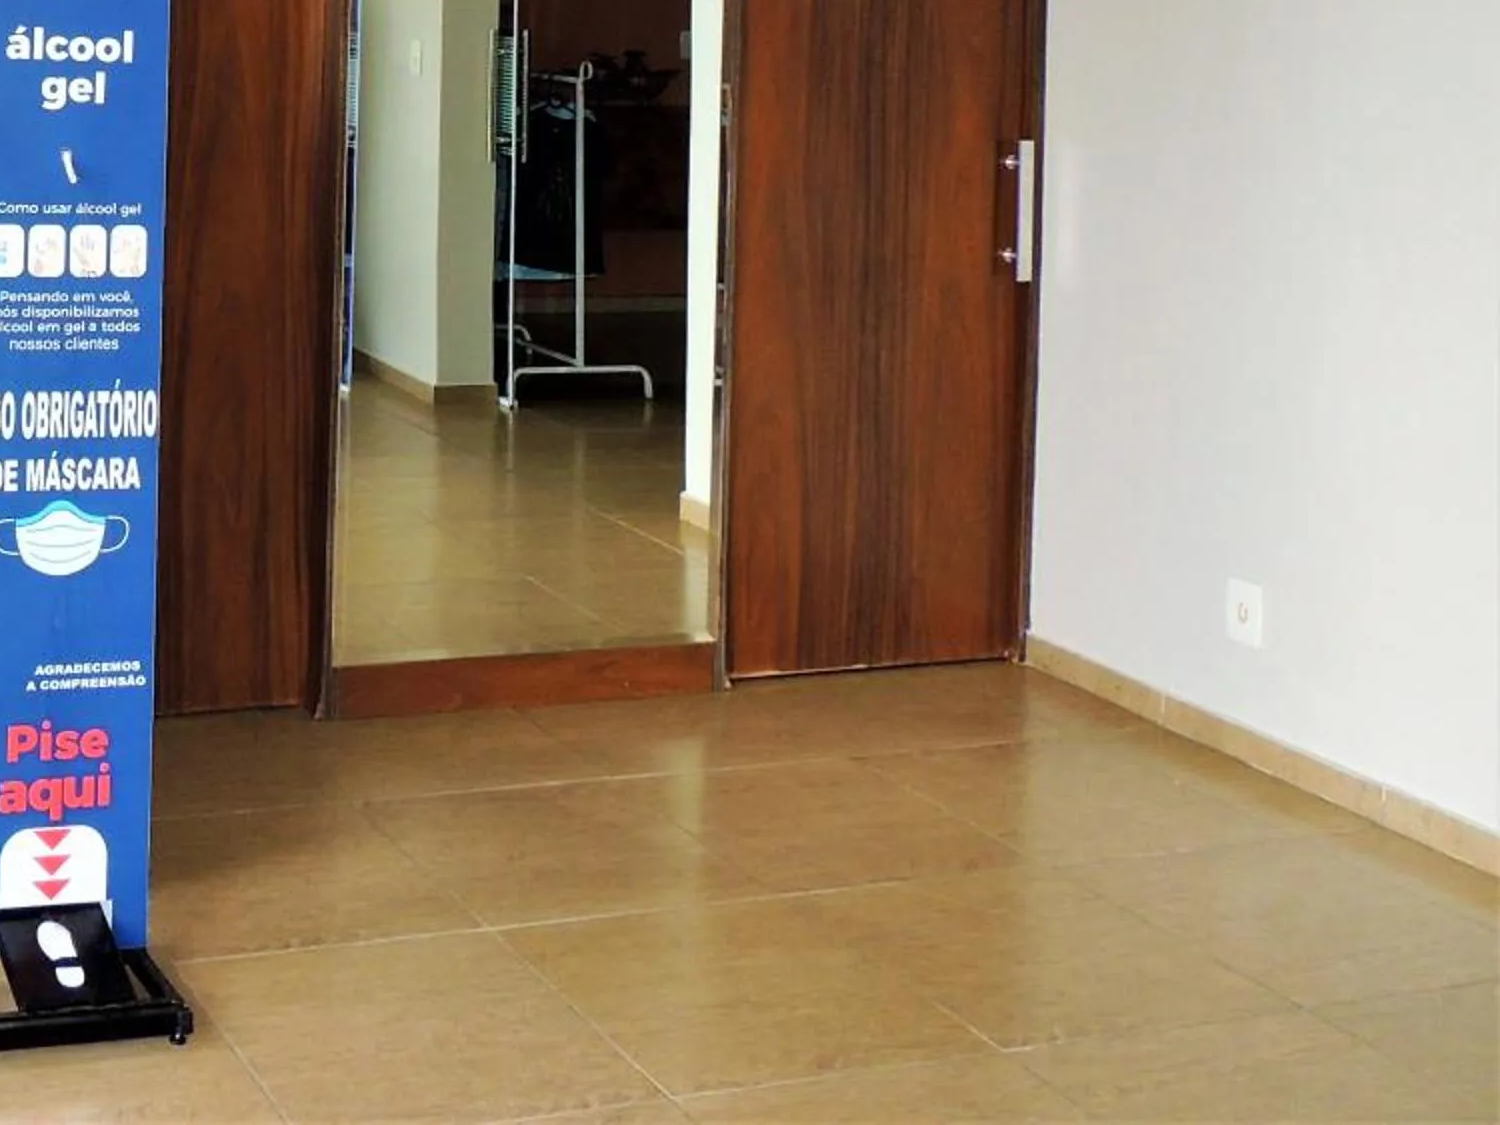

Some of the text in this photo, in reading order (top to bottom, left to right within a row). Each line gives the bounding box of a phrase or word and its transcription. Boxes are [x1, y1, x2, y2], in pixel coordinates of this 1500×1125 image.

[5, 25, 134, 63] álcool
[41, 71, 107, 110] gel
[43, 203, 72, 214] usar
[75, 202, 117, 215] álcool
[120, 203, 142, 217] gel
[0, 290, 133, 304] Pensando em você,
[21, 305, 140, 320] disponibilizamos
[37, 323, 61, 333] em
[64, 321, 85, 335] gel
[88, 324, 97, 333] a
[101, 321, 141, 332] todos
[9, 336, 119, 351] nossos clientes
[21, 378, 158, 439] OBRIGATÓRIO
[25, 451, 142, 492] MÁSCARA
[35, 660, 141, 675] AGRADECEMOS
[25, 674, 147, 691] A COMPREENSÃO
[7, 720, 109, 763] Pise
